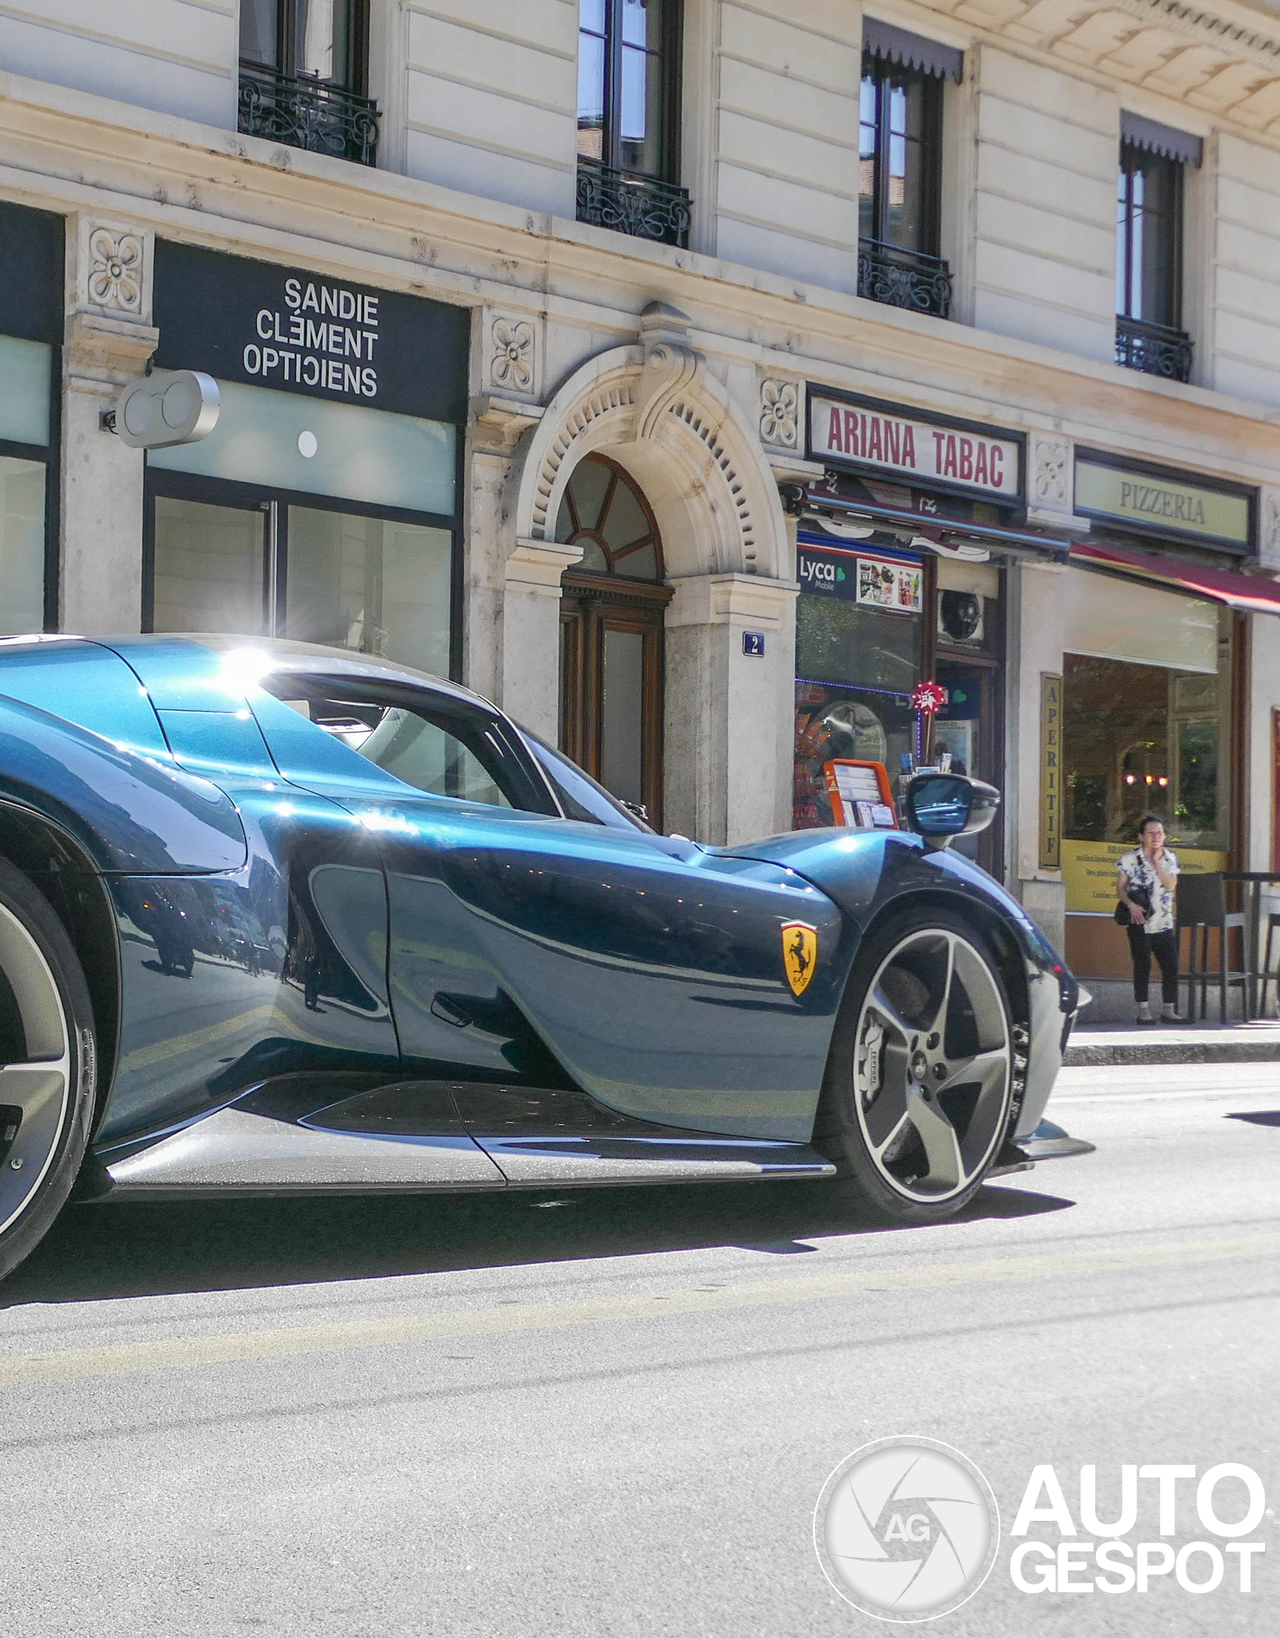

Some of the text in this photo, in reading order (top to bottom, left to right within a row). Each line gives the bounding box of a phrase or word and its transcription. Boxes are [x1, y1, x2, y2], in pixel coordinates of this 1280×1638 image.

[284, 278, 379, 326] SANDIE
[243, 343, 378, 397] OPTICIENS
[827, 406, 1003, 488] ARIANA TABAC
[1120, 481, 1207, 525] PIZZERIA
[800, 556, 835, 581] Lyca
[814, 579, 835, 591] Mobile
[751, 635, 759, 653] 2
[1045, 685, 1058, 854] APERITIF
